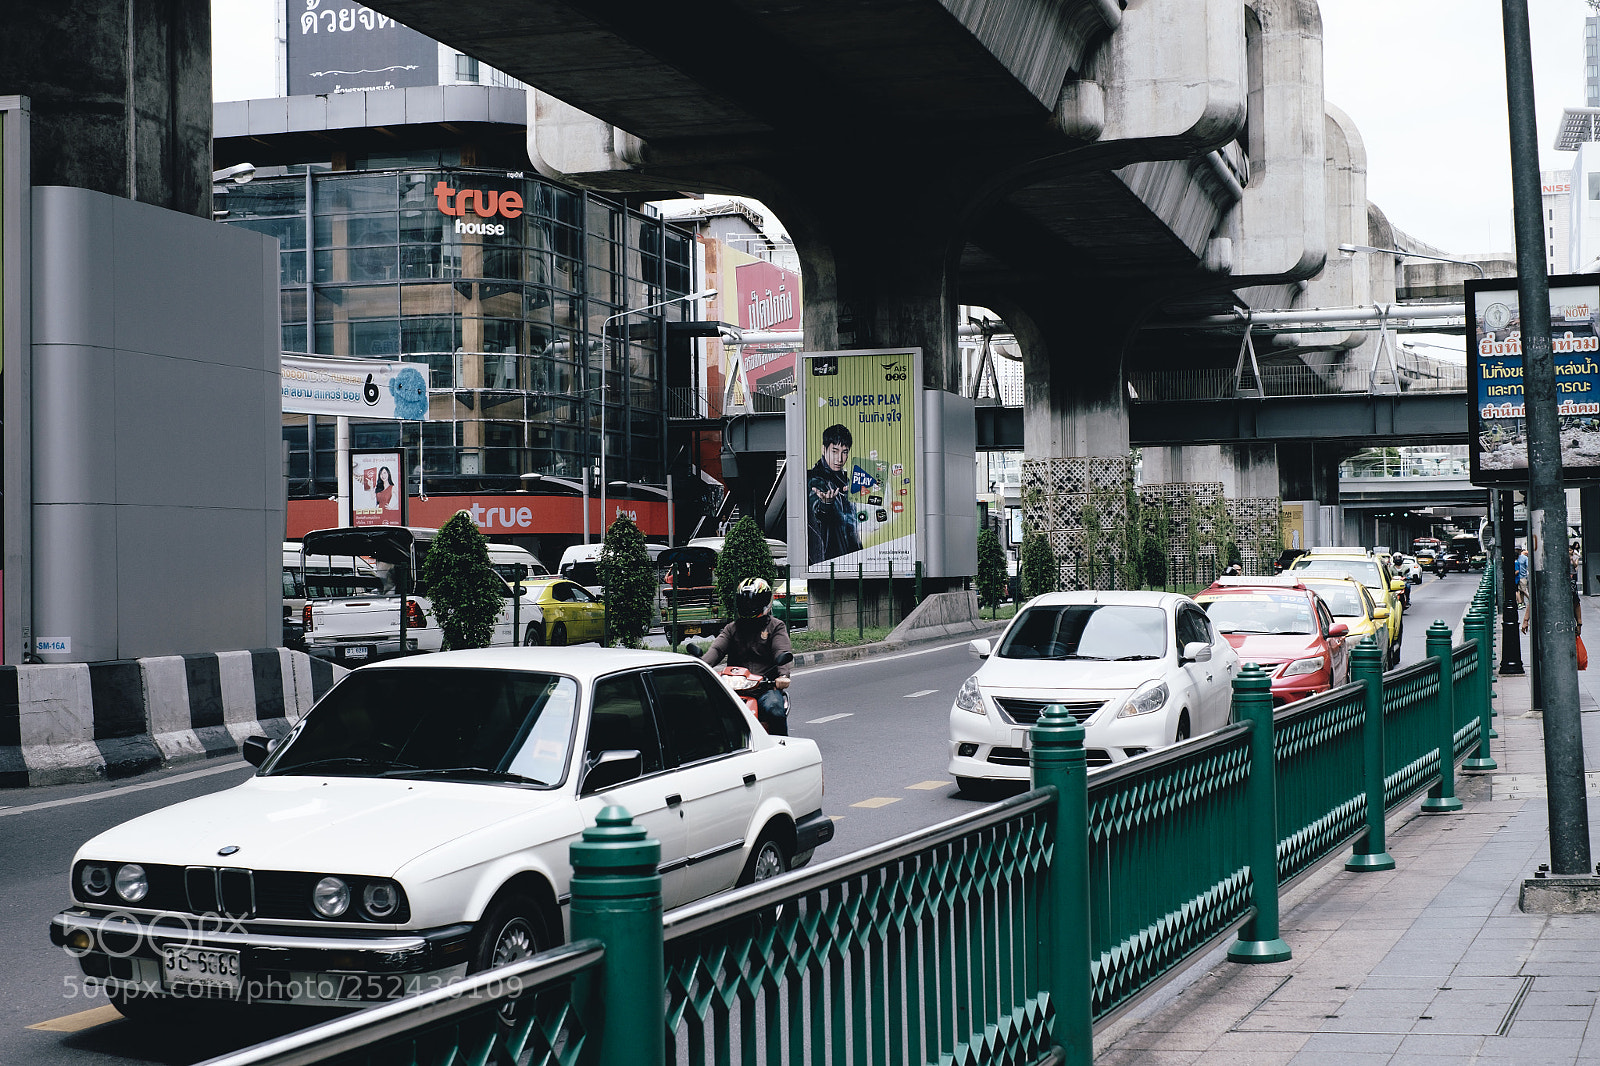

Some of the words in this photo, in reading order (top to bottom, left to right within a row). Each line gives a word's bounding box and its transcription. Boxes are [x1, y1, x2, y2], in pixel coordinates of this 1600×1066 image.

[434, 181, 523, 218] true
[455, 219, 504, 235] house
[1565, 308, 1589, 317] NOW!
[842, 395, 874, 406] SUPER
[878, 394, 901, 405] PLAY
[853, 476, 873, 485] PLAY
[470, 503, 532, 527] true
